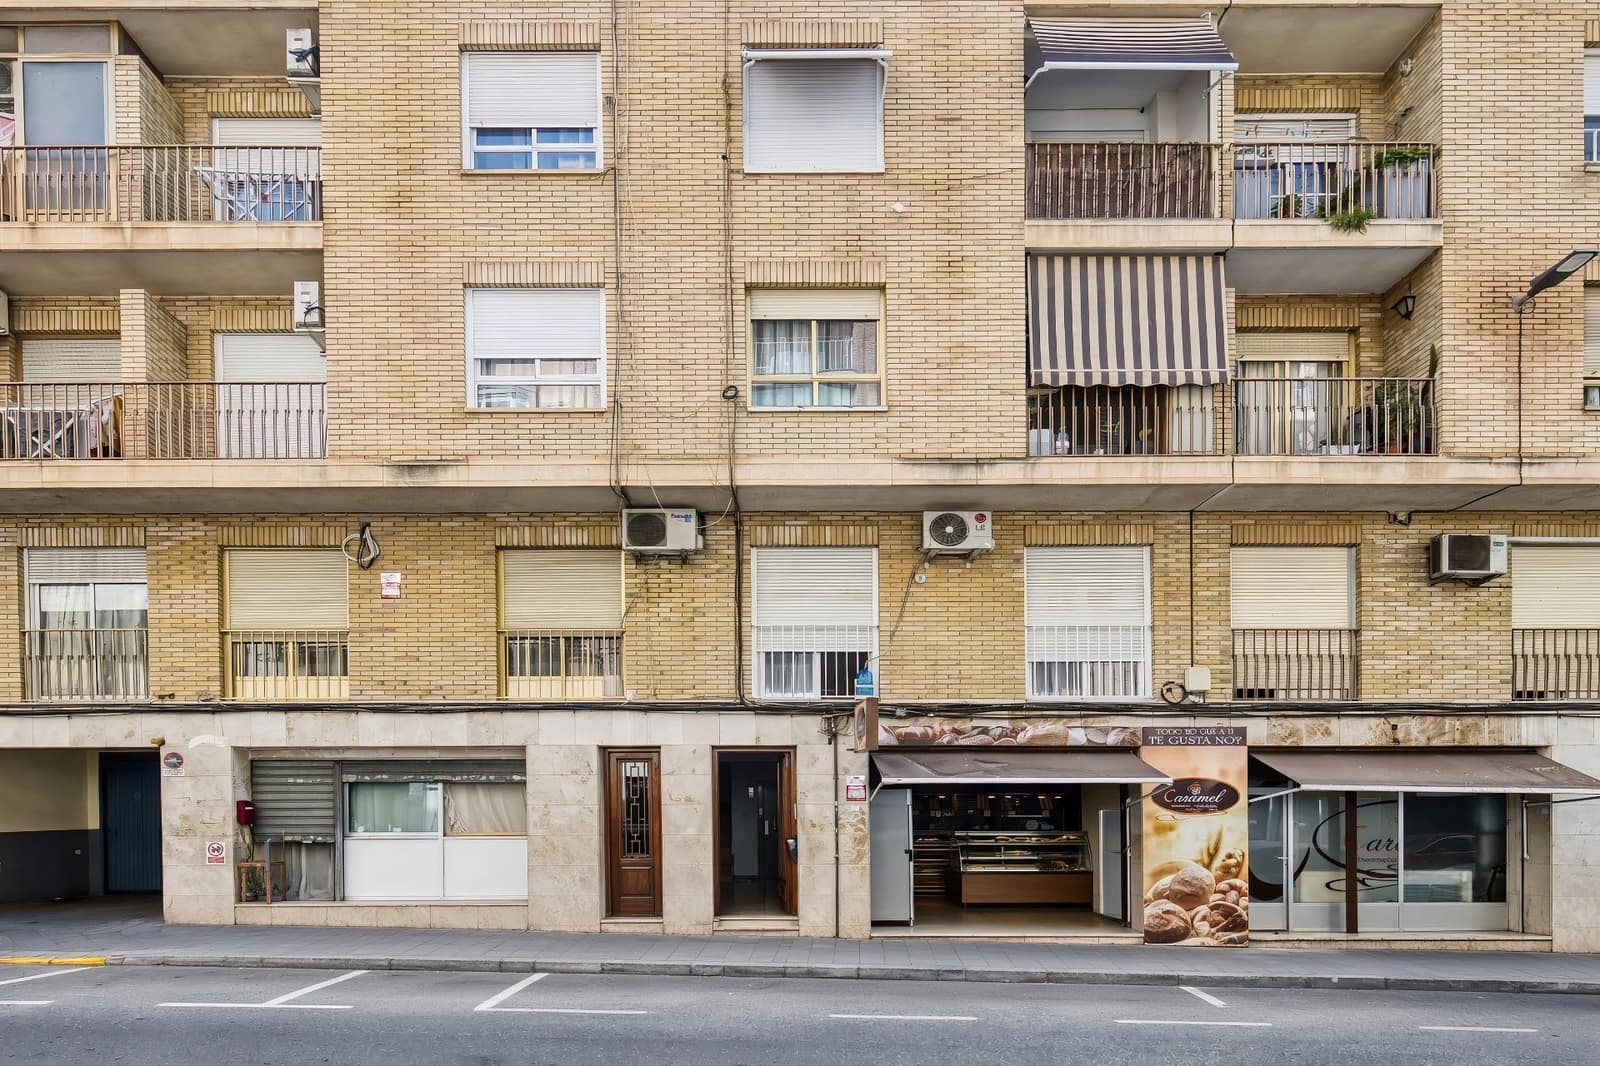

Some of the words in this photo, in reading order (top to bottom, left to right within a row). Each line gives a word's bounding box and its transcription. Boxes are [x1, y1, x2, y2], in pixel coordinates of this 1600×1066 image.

[1148, 736, 1164, 744] TE
[1168, 736, 1212, 744] GUSTA
[1163, 788, 1227, 803] Caramel
